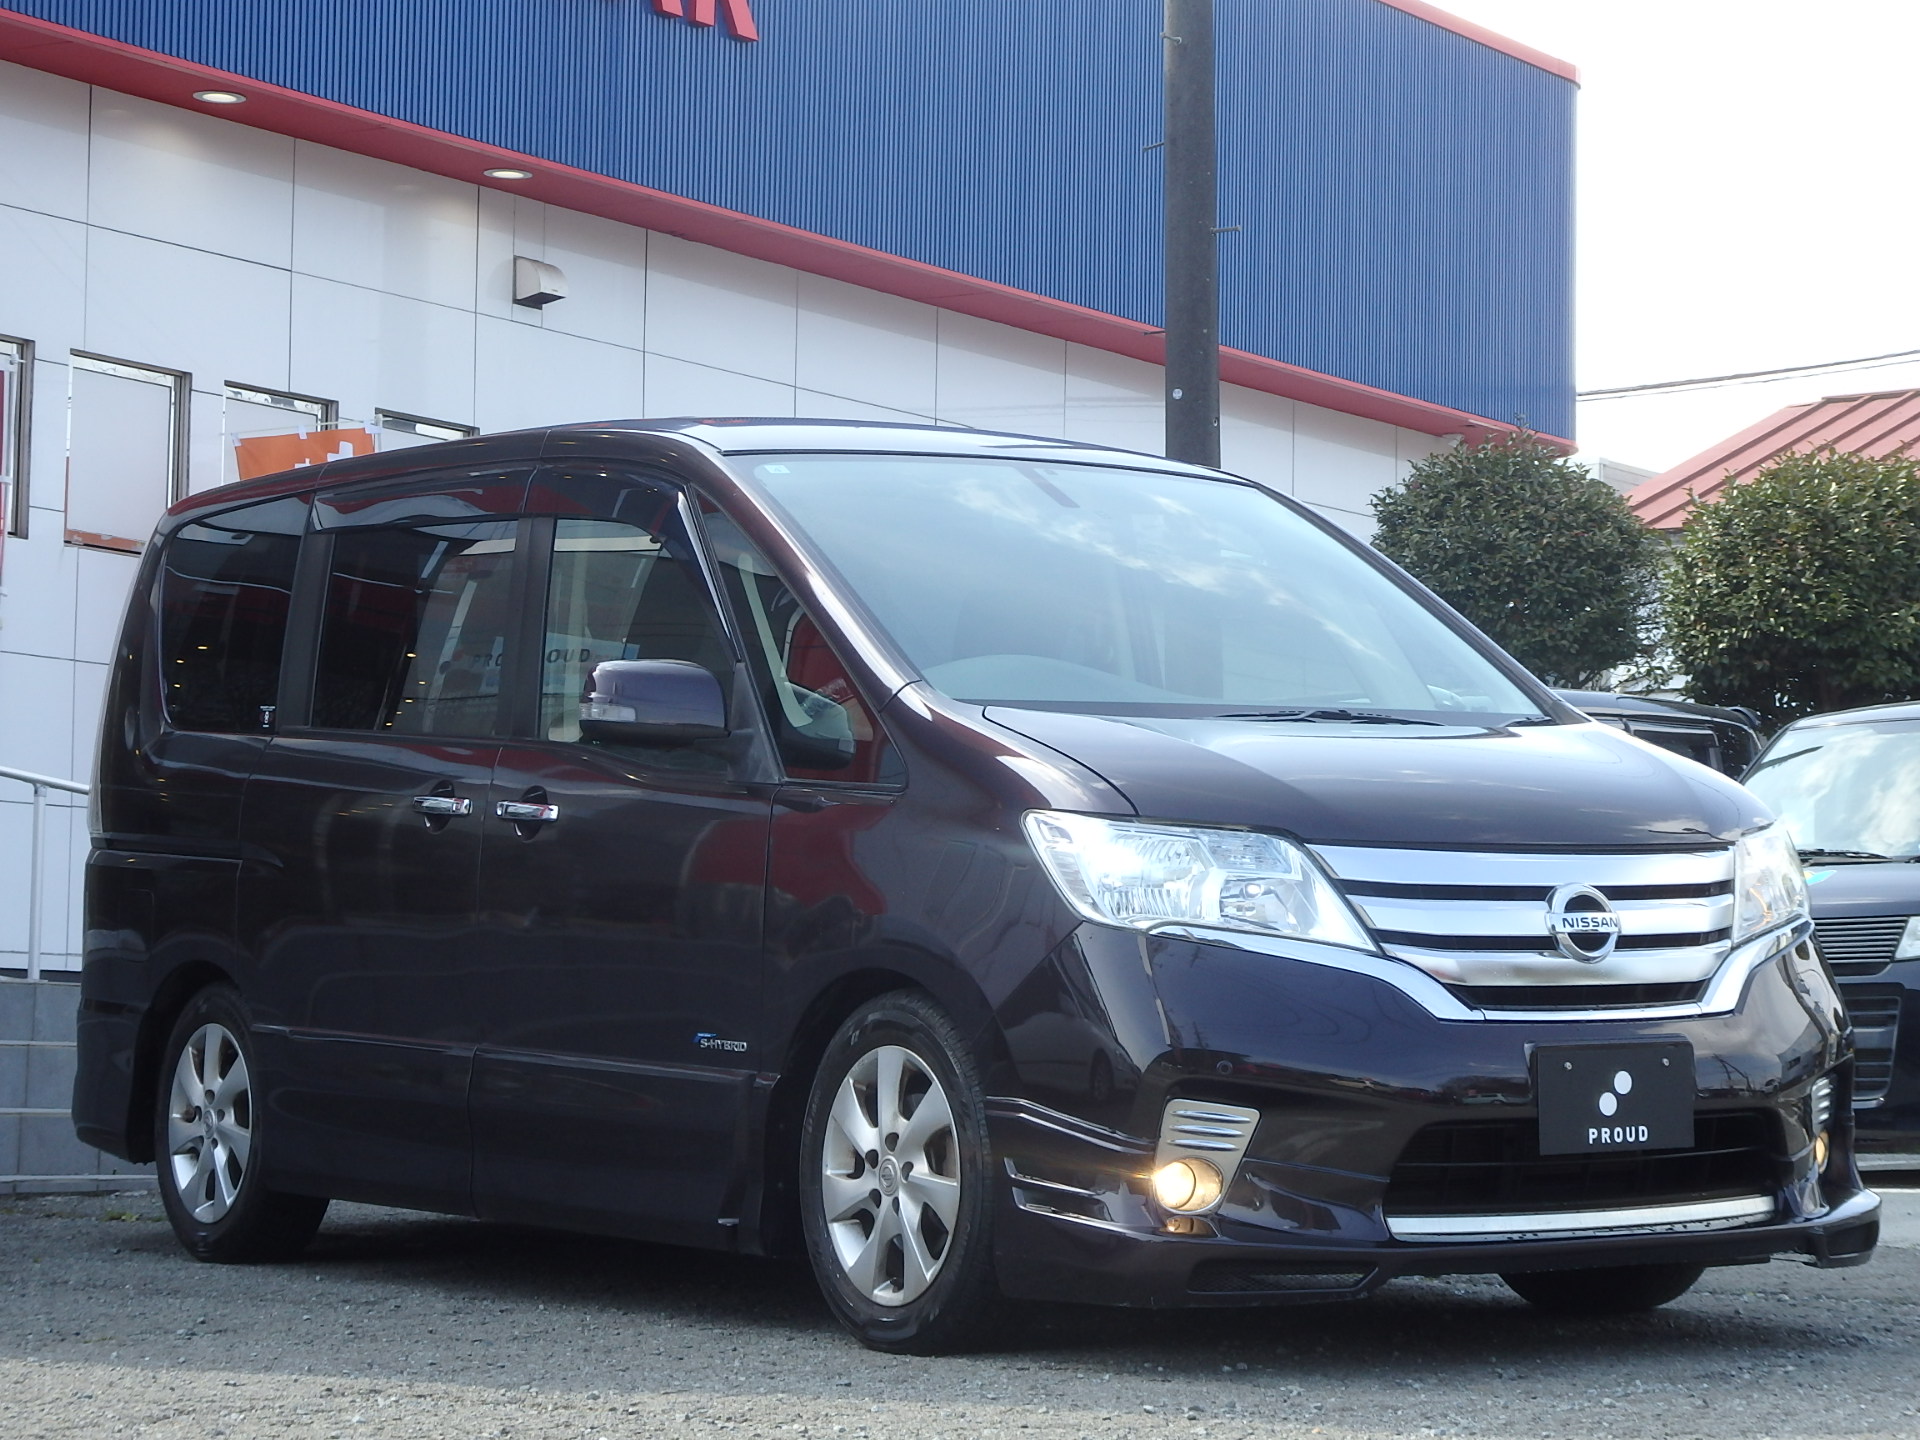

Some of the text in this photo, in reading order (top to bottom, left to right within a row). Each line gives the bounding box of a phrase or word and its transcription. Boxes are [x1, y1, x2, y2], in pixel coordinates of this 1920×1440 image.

[1562, 917, 1618, 928] NISSAN
[700, 1038, 747, 1052] S-HYBRID
[1588, 1125, 1649, 1145] PROUD
